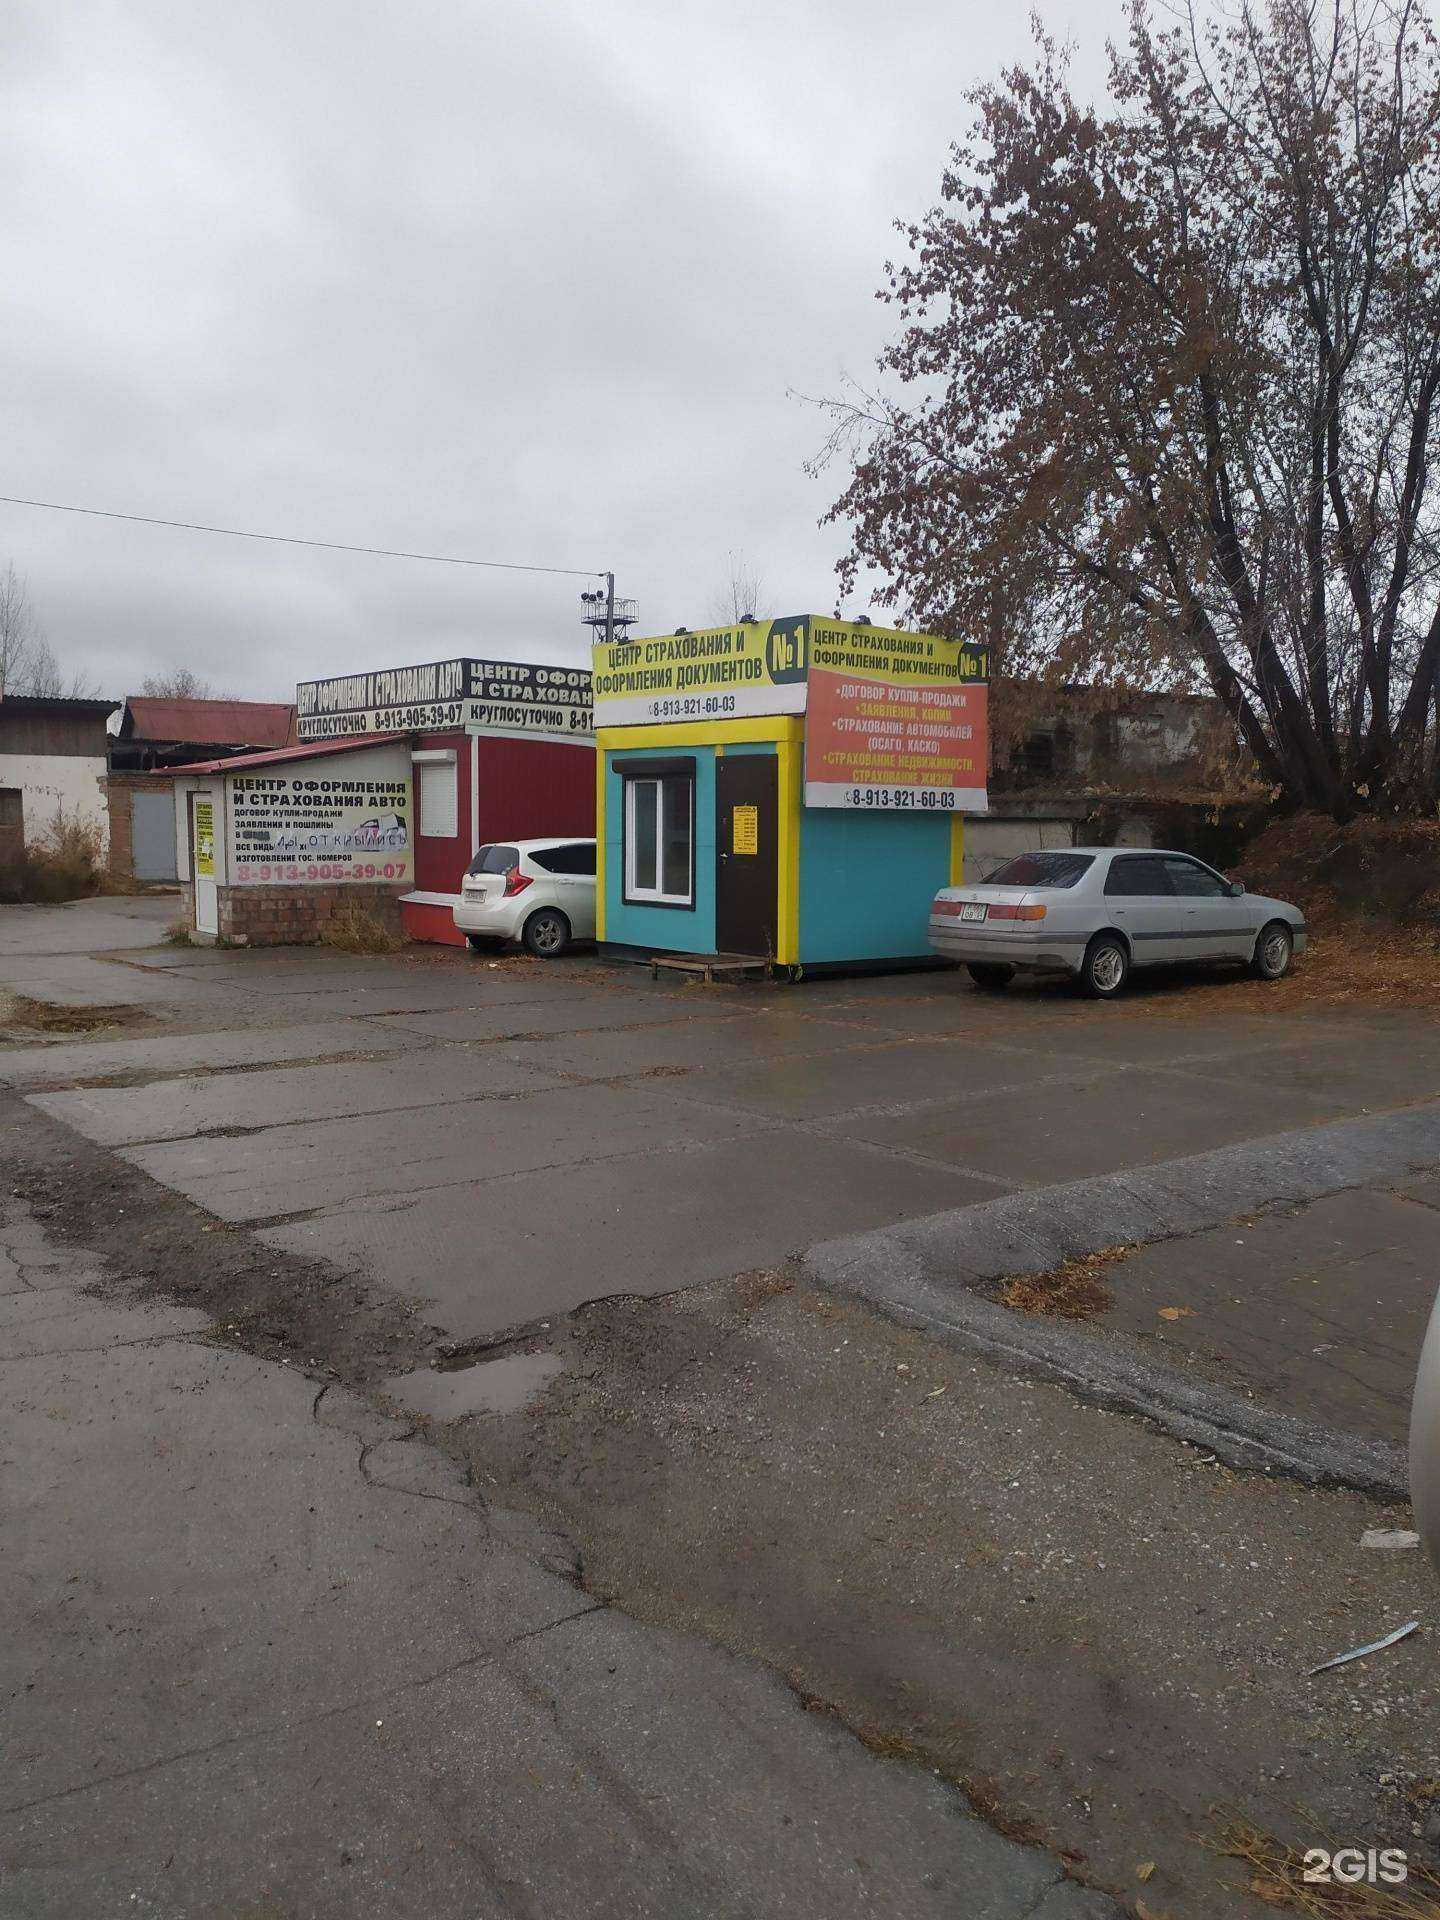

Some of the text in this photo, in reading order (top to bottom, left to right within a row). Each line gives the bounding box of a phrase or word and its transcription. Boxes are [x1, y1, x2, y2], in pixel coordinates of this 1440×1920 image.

[608, 631, 745, 670] ЦЕНТР СТРАХОВАНИЯ И
[814, 630, 933, 655] ЦЕНТР СТРАХОВАНИЯ И
[470, 663, 530, 681] ЦЕНТР
[814, 650, 958, 678] ОФОРМЛЕНИЯ ДОКУМЕНТОВ
[596, 657, 762, 695] ОФОРМЛЕНИЯ ДОКУМЕНТОВ
[318, 676, 367, 712] ОФОРМЛЕНИЯ
[375, 665, 436, 706] СТРАХОВАНИЯ
[438, 660, 463, 698] АВТО
[470, 681, 483, 696] И
[841, 685, 967, 708] ДОГОВОР КУПЛИ-ПРОДАЖИ
[653, 696, 735, 716] 8-913-921-60-03
[298, 703, 463, 736] КРУГЛОСУТОЧНО 8-913-905-39-07
[470, 705, 563, 726] КРУГЛОСУТОЧНО
[837, 718, 973, 739] СТРАХОВАНИЕ АВТОМОБИЛЕЙ
[908, 739, 940, 754] КАСКО)
[827, 752, 895, 769] СТРАХОВАНИЕ
[233, 778, 406, 794] ЦЕНТР ОФОРМЛЕНИЯ
[852, 769, 953, 786] СТРАХОВАНИЕ ЖИЗНИ
[233, 794, 407, 807] И СТРАХОВАНИЯ АВТО
[853, 789, 955, 808] 8-913-921-60-03
[234, 809, 343, 818] ДОГОВОР КУПЛИ-ПРОДАЖИ
[235, 820, 283, 828] ЗАЯВЛЕНИЯ
[293, 821, 333, 829] ПОШЛИНЫ
[235, 843, 251, 851] ВСЕ
[236, 854, 353, 863] ИЗГОТОВЛЕНИЕ ГОС. НОМЕРОВ
[238, 864, 406, 881] 8-913-905-39-07
